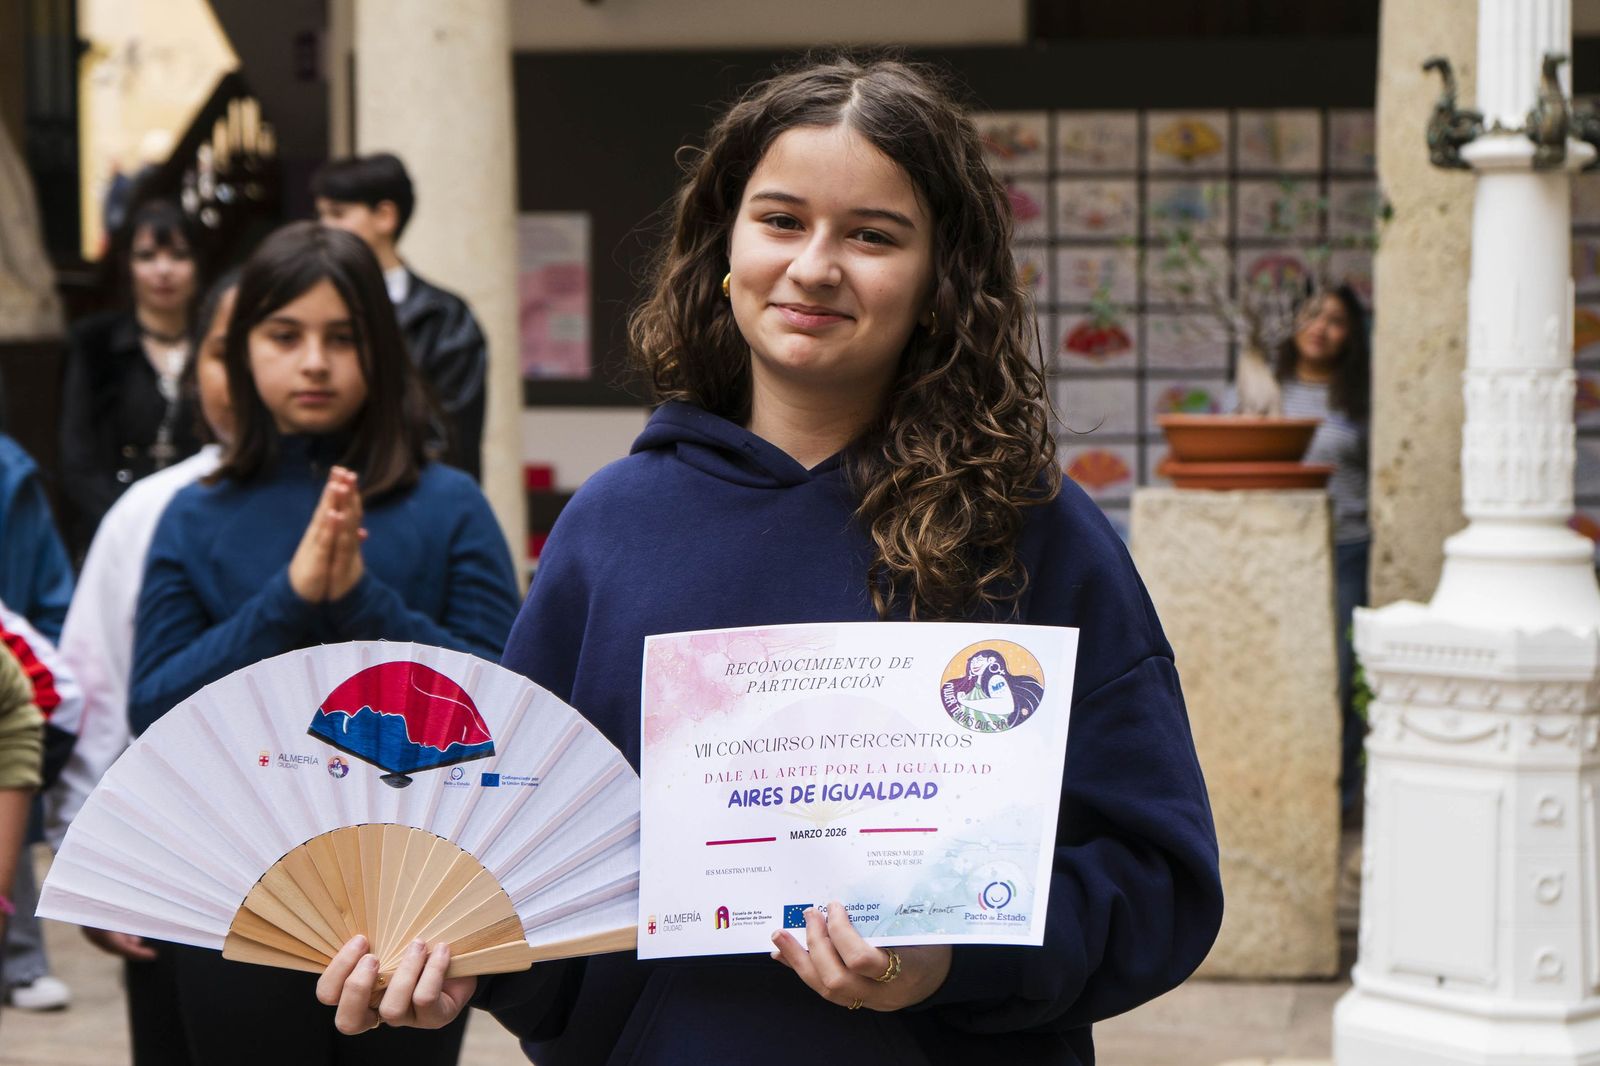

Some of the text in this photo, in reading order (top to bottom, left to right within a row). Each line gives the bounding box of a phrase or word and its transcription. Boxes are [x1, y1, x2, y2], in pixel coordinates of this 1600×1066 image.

[724, 656, 914, 676] RECONOCIMIENTO DE
[746, 673, 885, 694] PARTICIPACIÓN
[695, 733, 973, 758] VII CONCURSO INTERCENTROS
[278, 753, 319, 765] ALMERÍA
[704, 762, 992, 784] DALE AL ARTE POR LA IGUALDAD
[728, 781, 938, 808] AIRES DE IGUALDAD
[790, 828, 847, 840] MARZO 2026
[715, 867, 745, 875] MAESTRO
[866, 903, 880, 911] por
[663, 910, 702, 924] ALMERÍA
[848, 914, 880, 923] Europea
[963, 912, 988, 920] Pacto
[996, 912, 1026, 921] Estado
